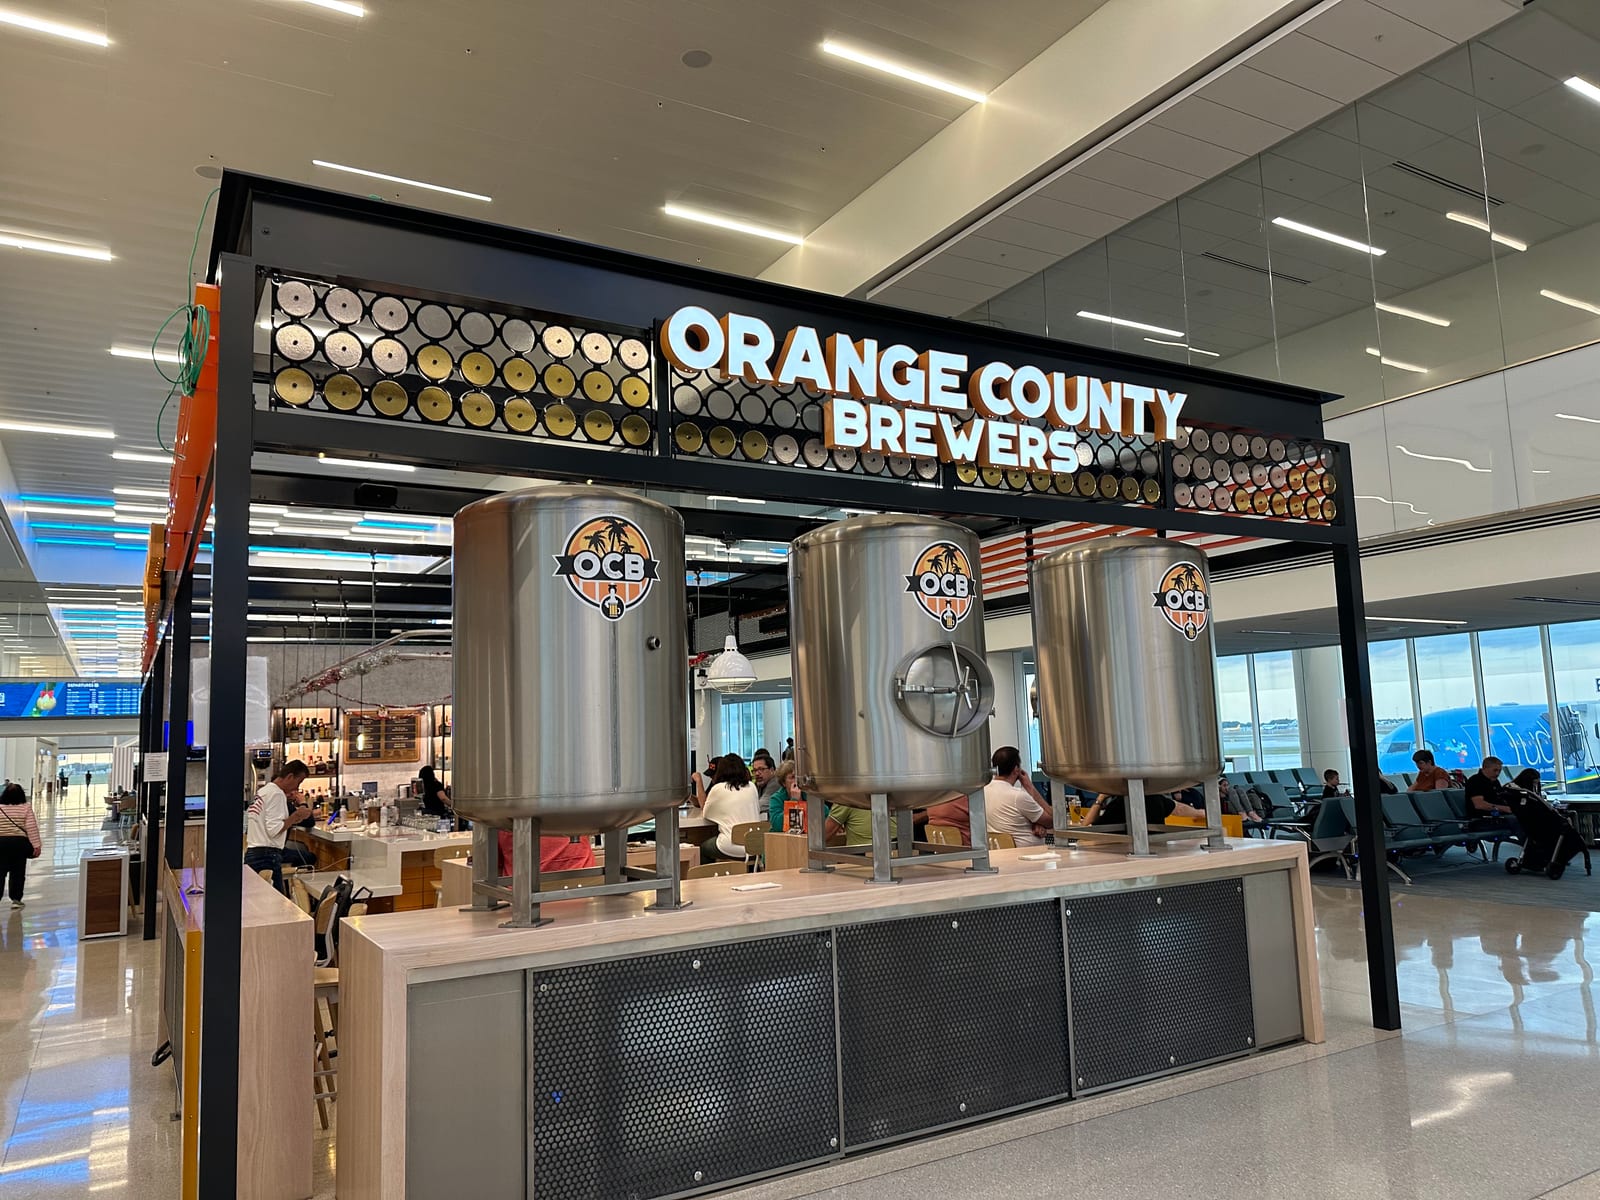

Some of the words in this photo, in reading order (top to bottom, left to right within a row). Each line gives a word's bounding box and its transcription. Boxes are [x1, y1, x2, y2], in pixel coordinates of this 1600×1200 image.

[663, 305, 968, 411] ORANGE
[972, 361, 1188, 441] COUNTY
[829, 398, 1080, 474] BREWERS
[573, 551, 645, 581] OCB
[919, 572, 969, 597] OCB
[1165, 589, 1205, 611] OCB
